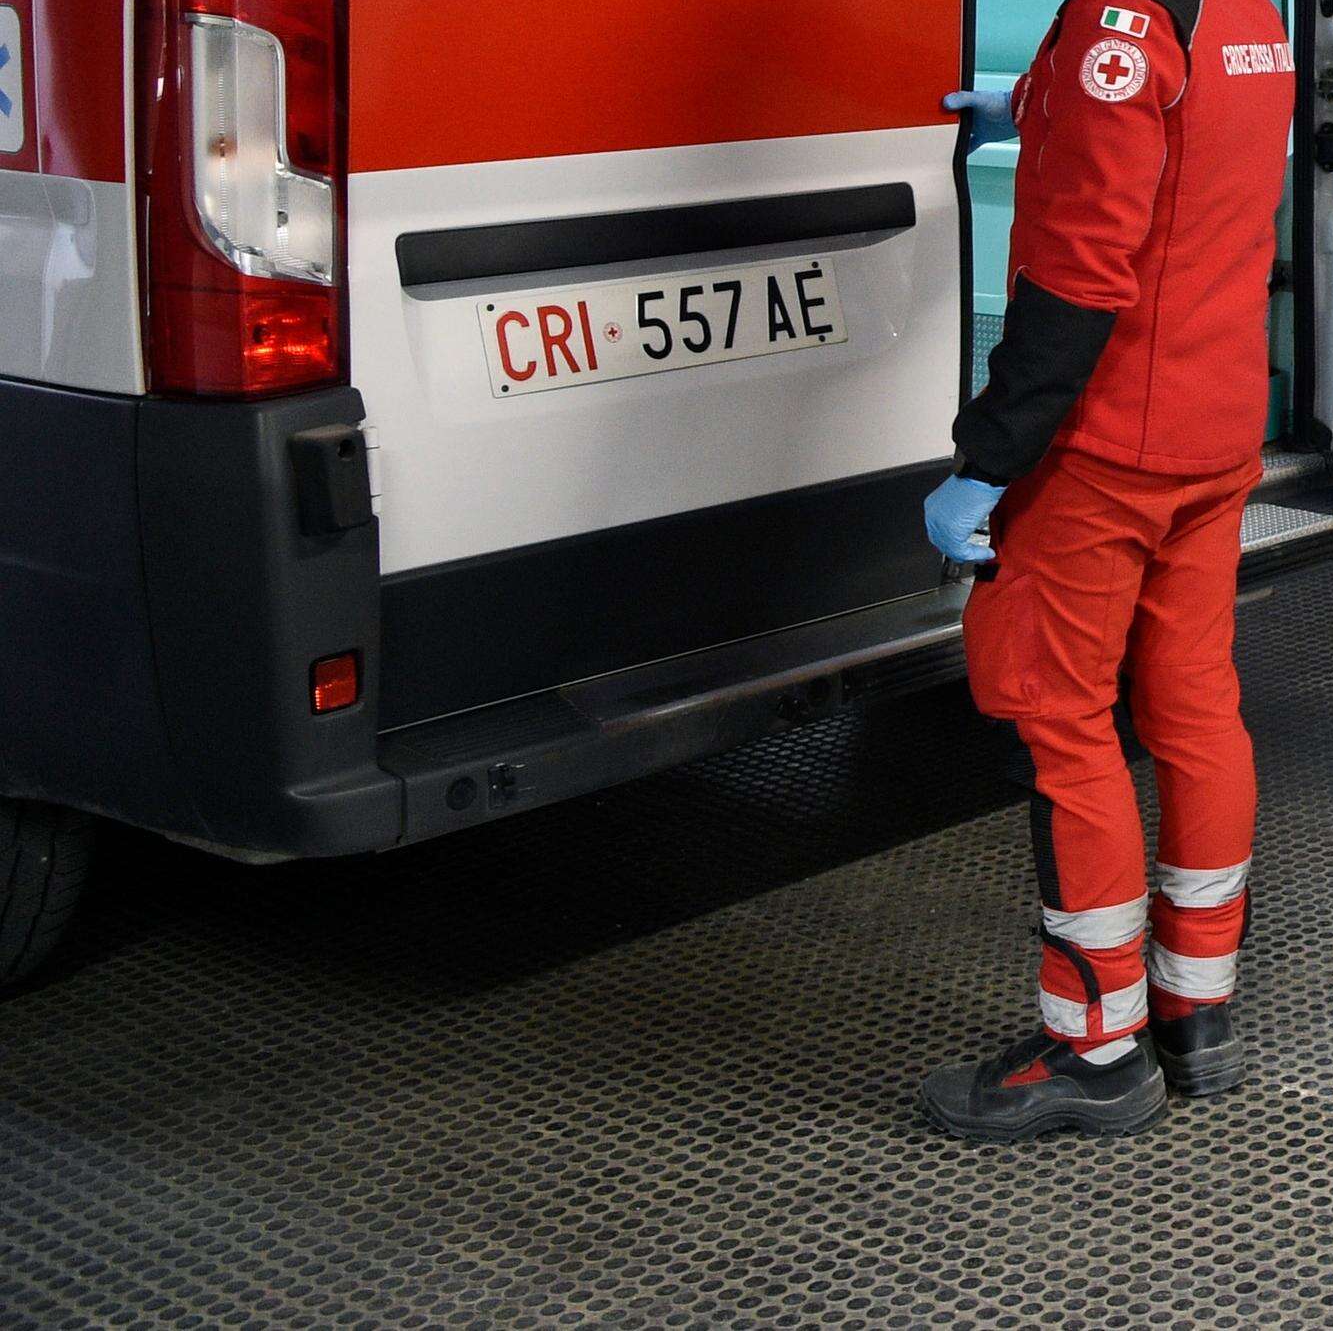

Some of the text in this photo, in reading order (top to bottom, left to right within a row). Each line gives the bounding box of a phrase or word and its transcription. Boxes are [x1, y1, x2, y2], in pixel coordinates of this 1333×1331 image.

[495, 268, 834, 383] CRI 557 AE
